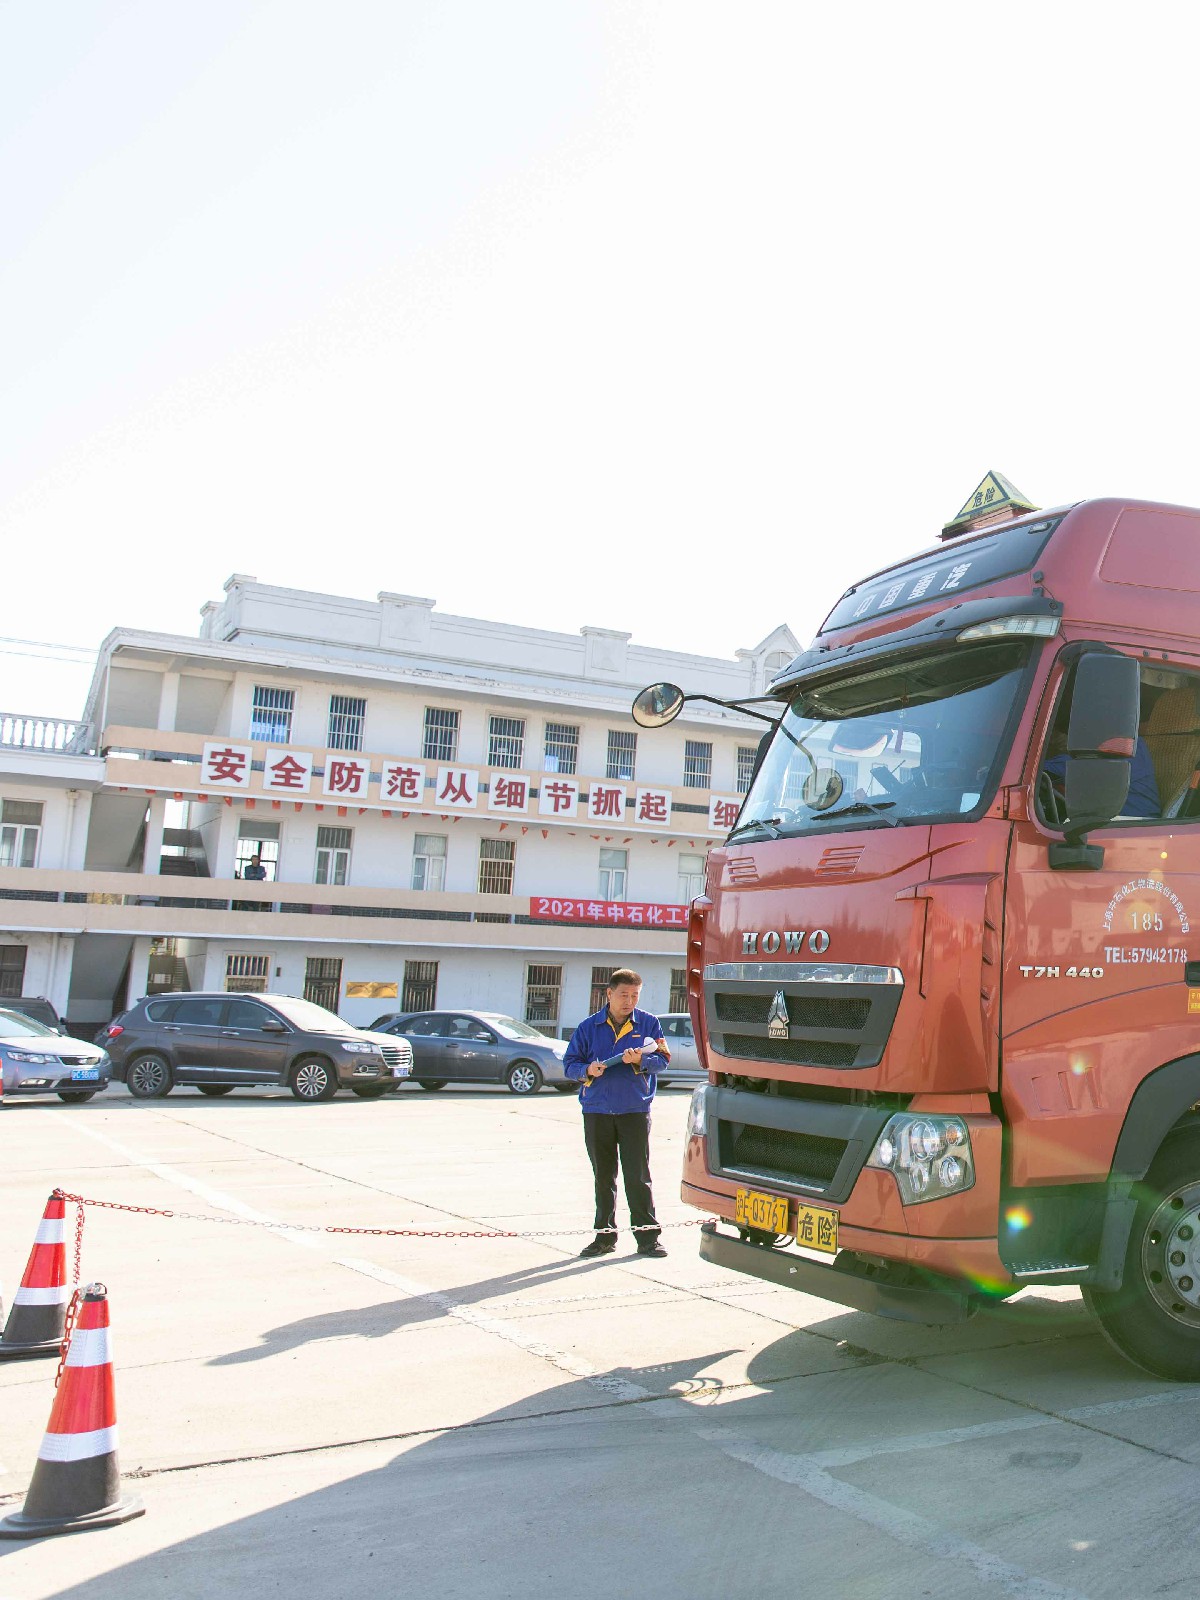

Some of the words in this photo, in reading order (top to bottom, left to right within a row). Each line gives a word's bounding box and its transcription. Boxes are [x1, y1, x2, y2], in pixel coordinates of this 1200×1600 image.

[208, 747, 668, 822] 安全防范从细节抓起
[1131, 911, 1164, 932] 185
[740, 929, 831, 956] HOWO
[1103, 946, 1188, 964] TEL:57942178
[1019, 965, 1060, 979] T7H
[1065, 966, 1104, 979] 440
[799, 1211, 833, 1247] 危险
